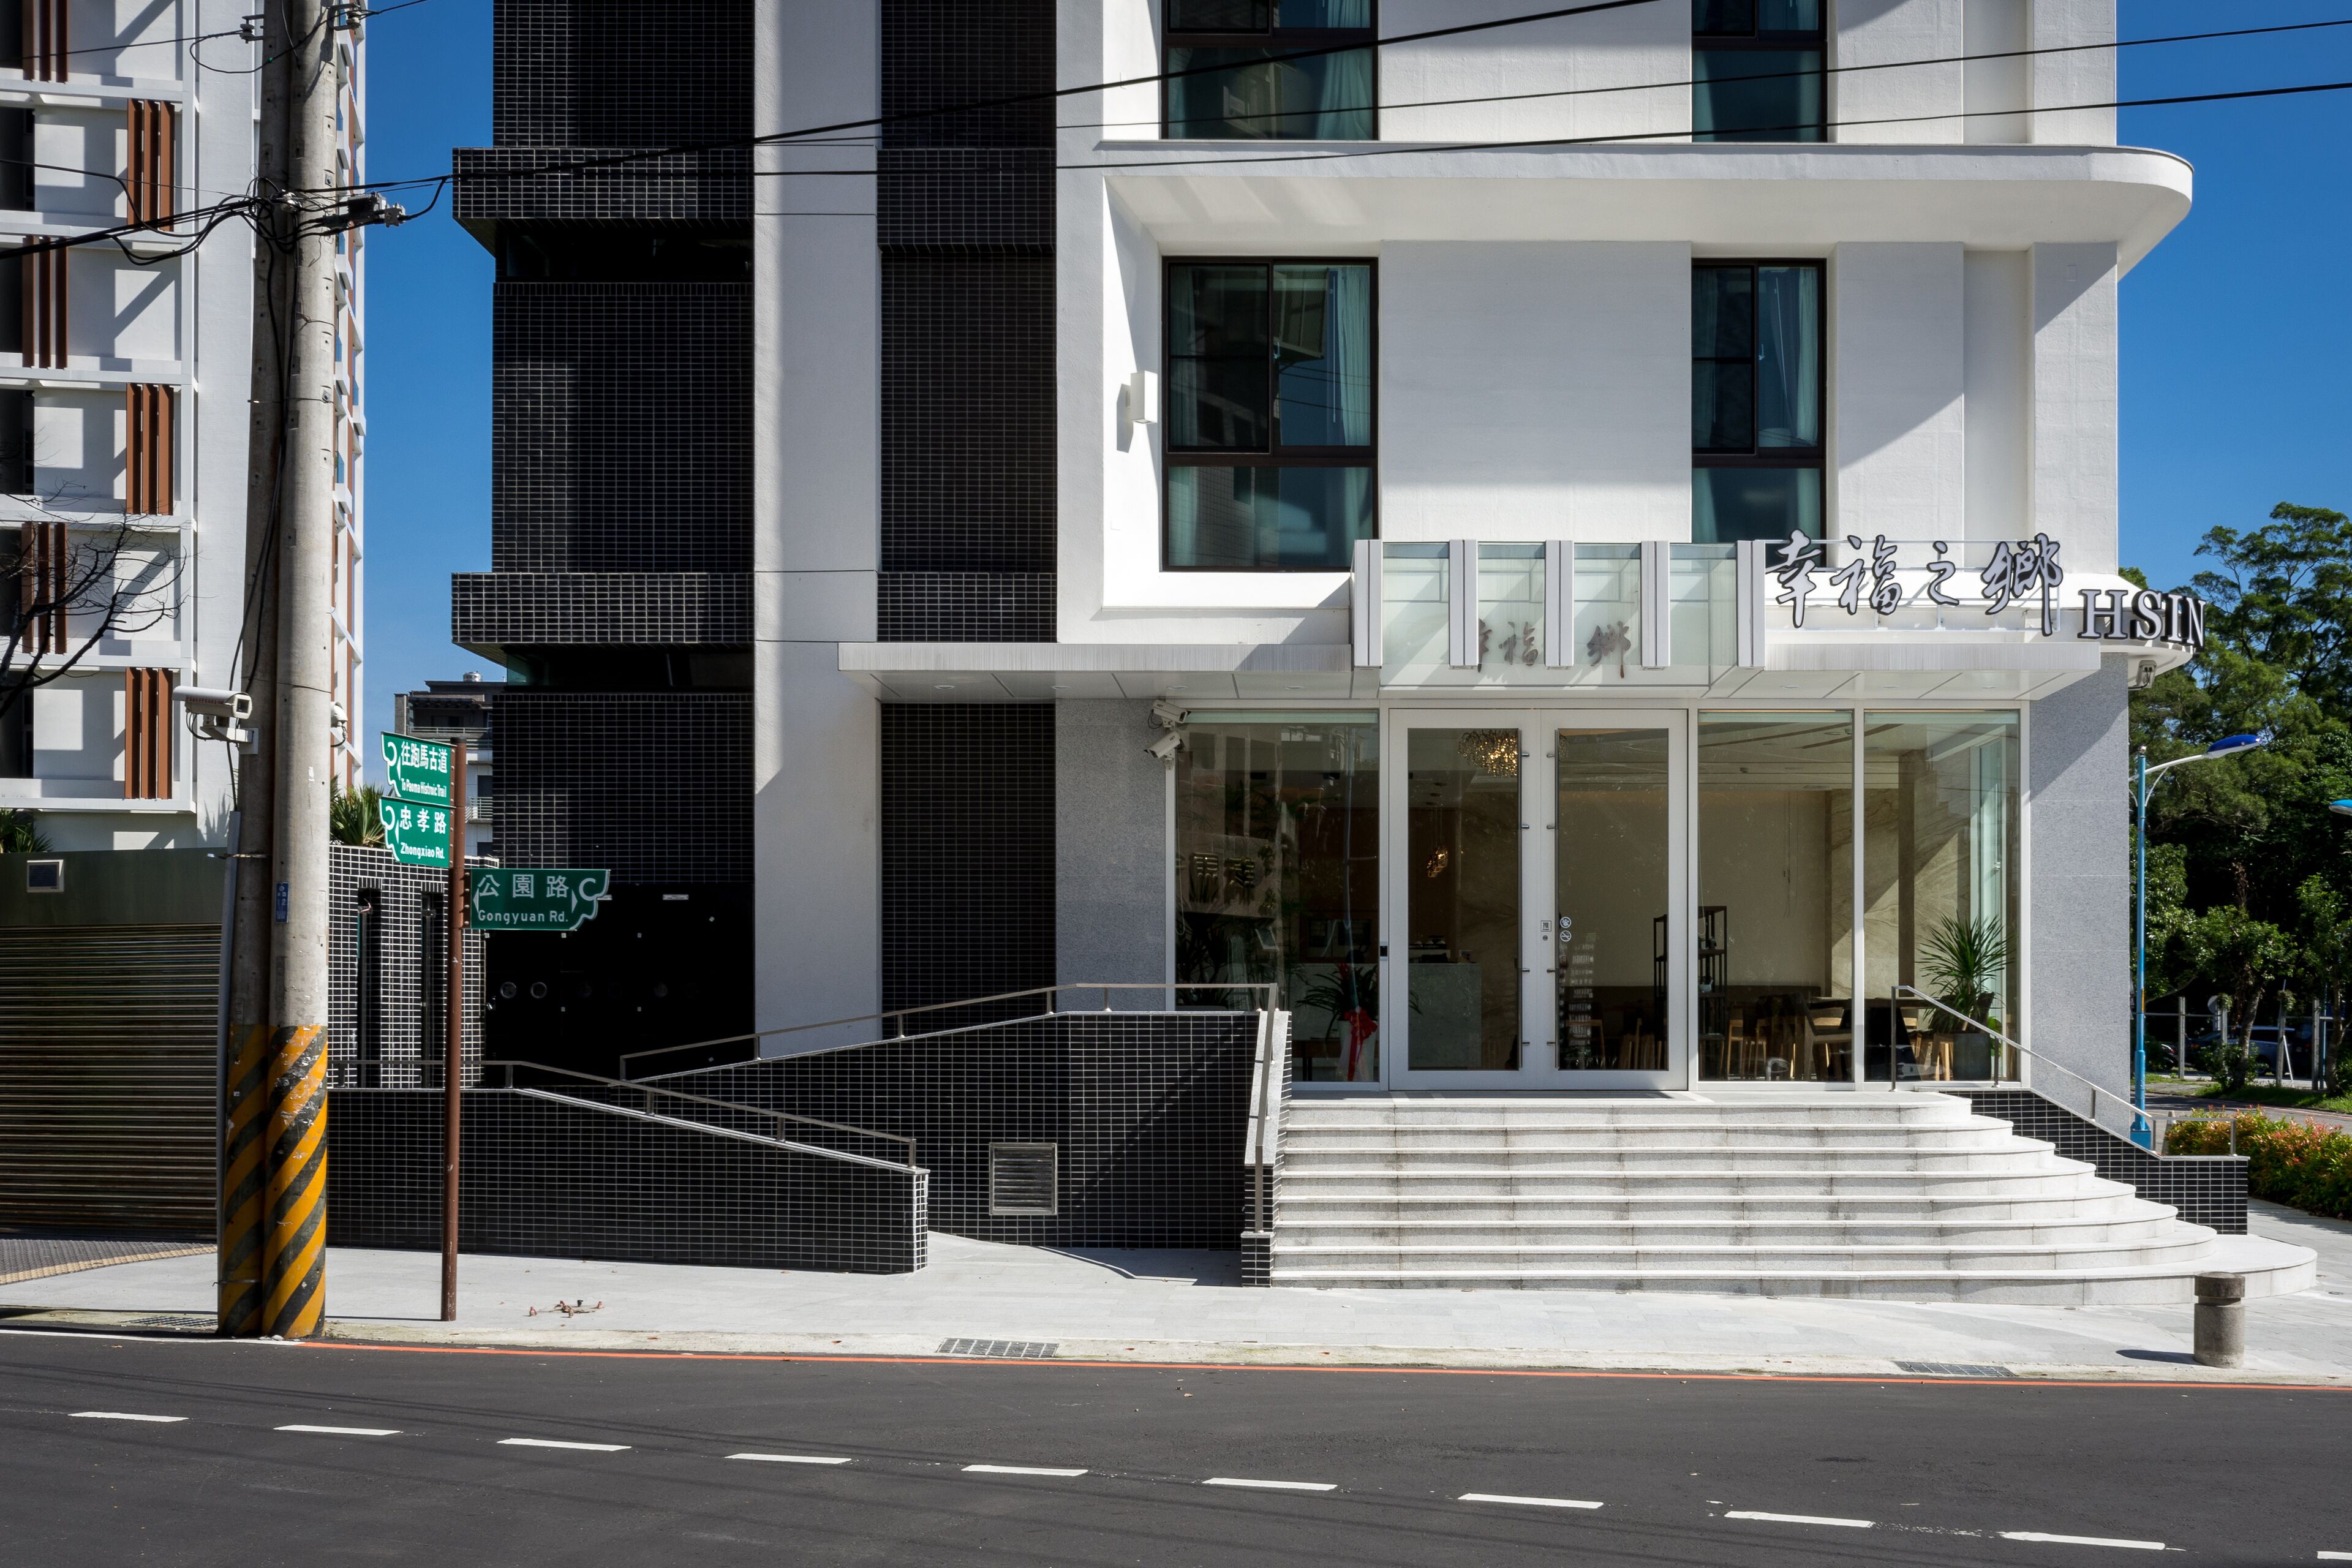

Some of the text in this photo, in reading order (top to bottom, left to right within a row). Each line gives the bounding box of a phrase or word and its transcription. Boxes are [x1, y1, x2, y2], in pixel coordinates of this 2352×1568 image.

[2077, 589, 2206, 649] HSIN
[401, 741, 448, 774] 往跑馬古道
[401, 778, 406, 791] To
[406, 778, 420, 794] Paoma
[437, 784, 447, 798] Trail
[399, 805, 447, 834] 忠孝路
[400, 842, 445, 859] Zhongxiao Rd.
[477, 874, 569, 898] 公園路
[478, 910, 568, 925] Gongyuan Rd.
